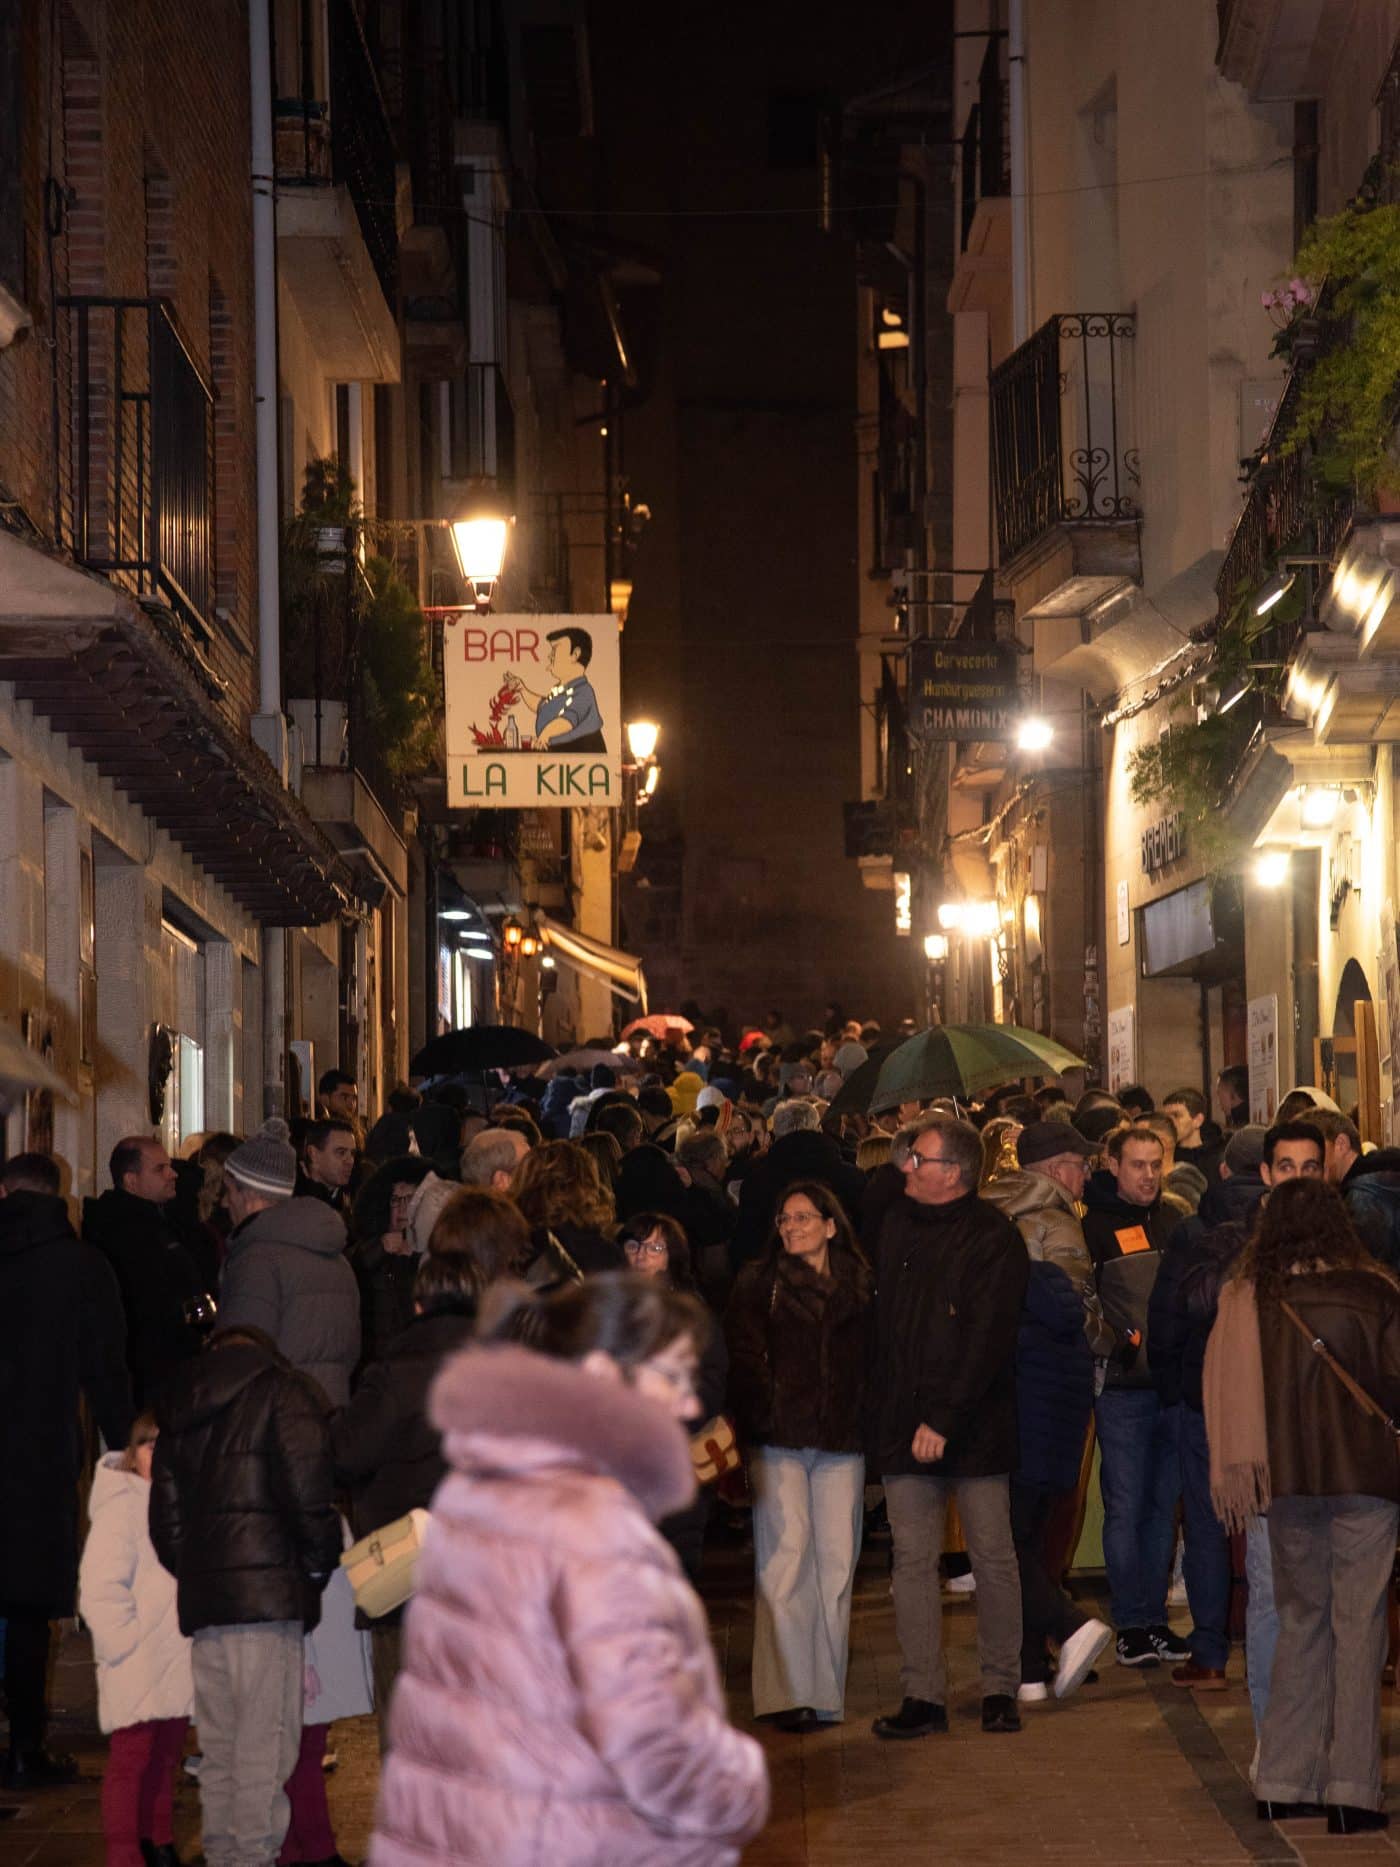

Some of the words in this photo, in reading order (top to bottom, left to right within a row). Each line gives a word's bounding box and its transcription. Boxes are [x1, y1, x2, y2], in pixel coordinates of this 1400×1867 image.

[464, 628, 540, 662] BAR
[924, 708, 1008, 728] CHAMONIX
[462, 763, 507, 796] LA
[537, 763, 610, 796] KIKA
[1141, 811, 1181, 873] BREMEN
